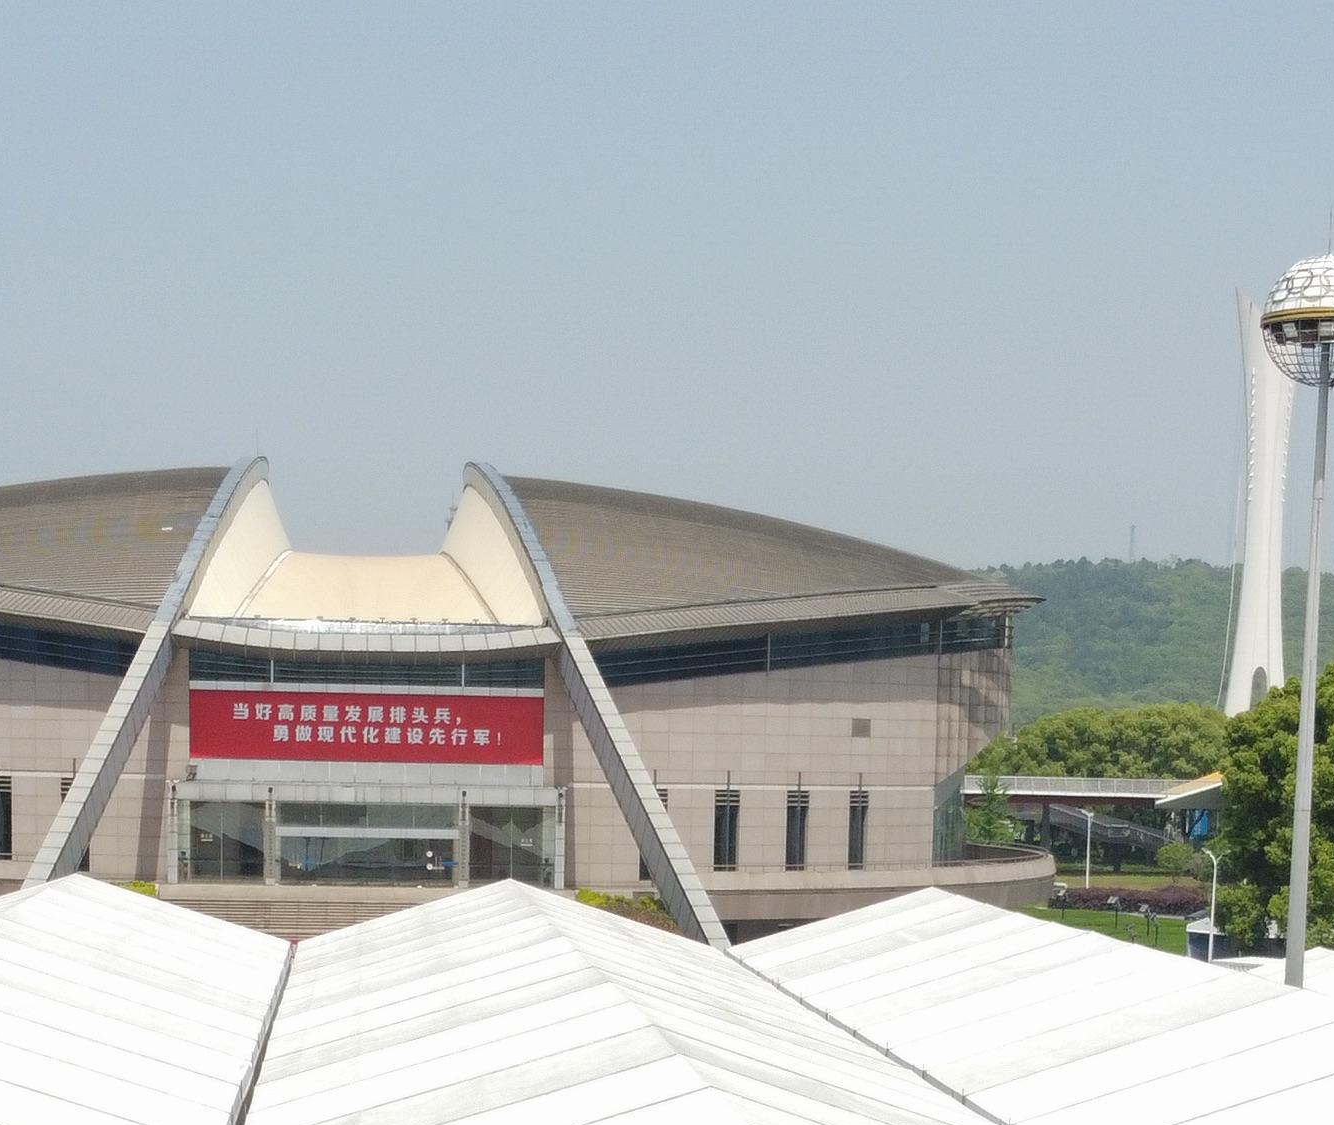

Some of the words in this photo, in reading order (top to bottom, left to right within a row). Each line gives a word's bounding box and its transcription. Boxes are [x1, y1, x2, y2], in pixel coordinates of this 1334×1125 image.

[233, 703, 462, 726] 当好高质量发展排头兵，
